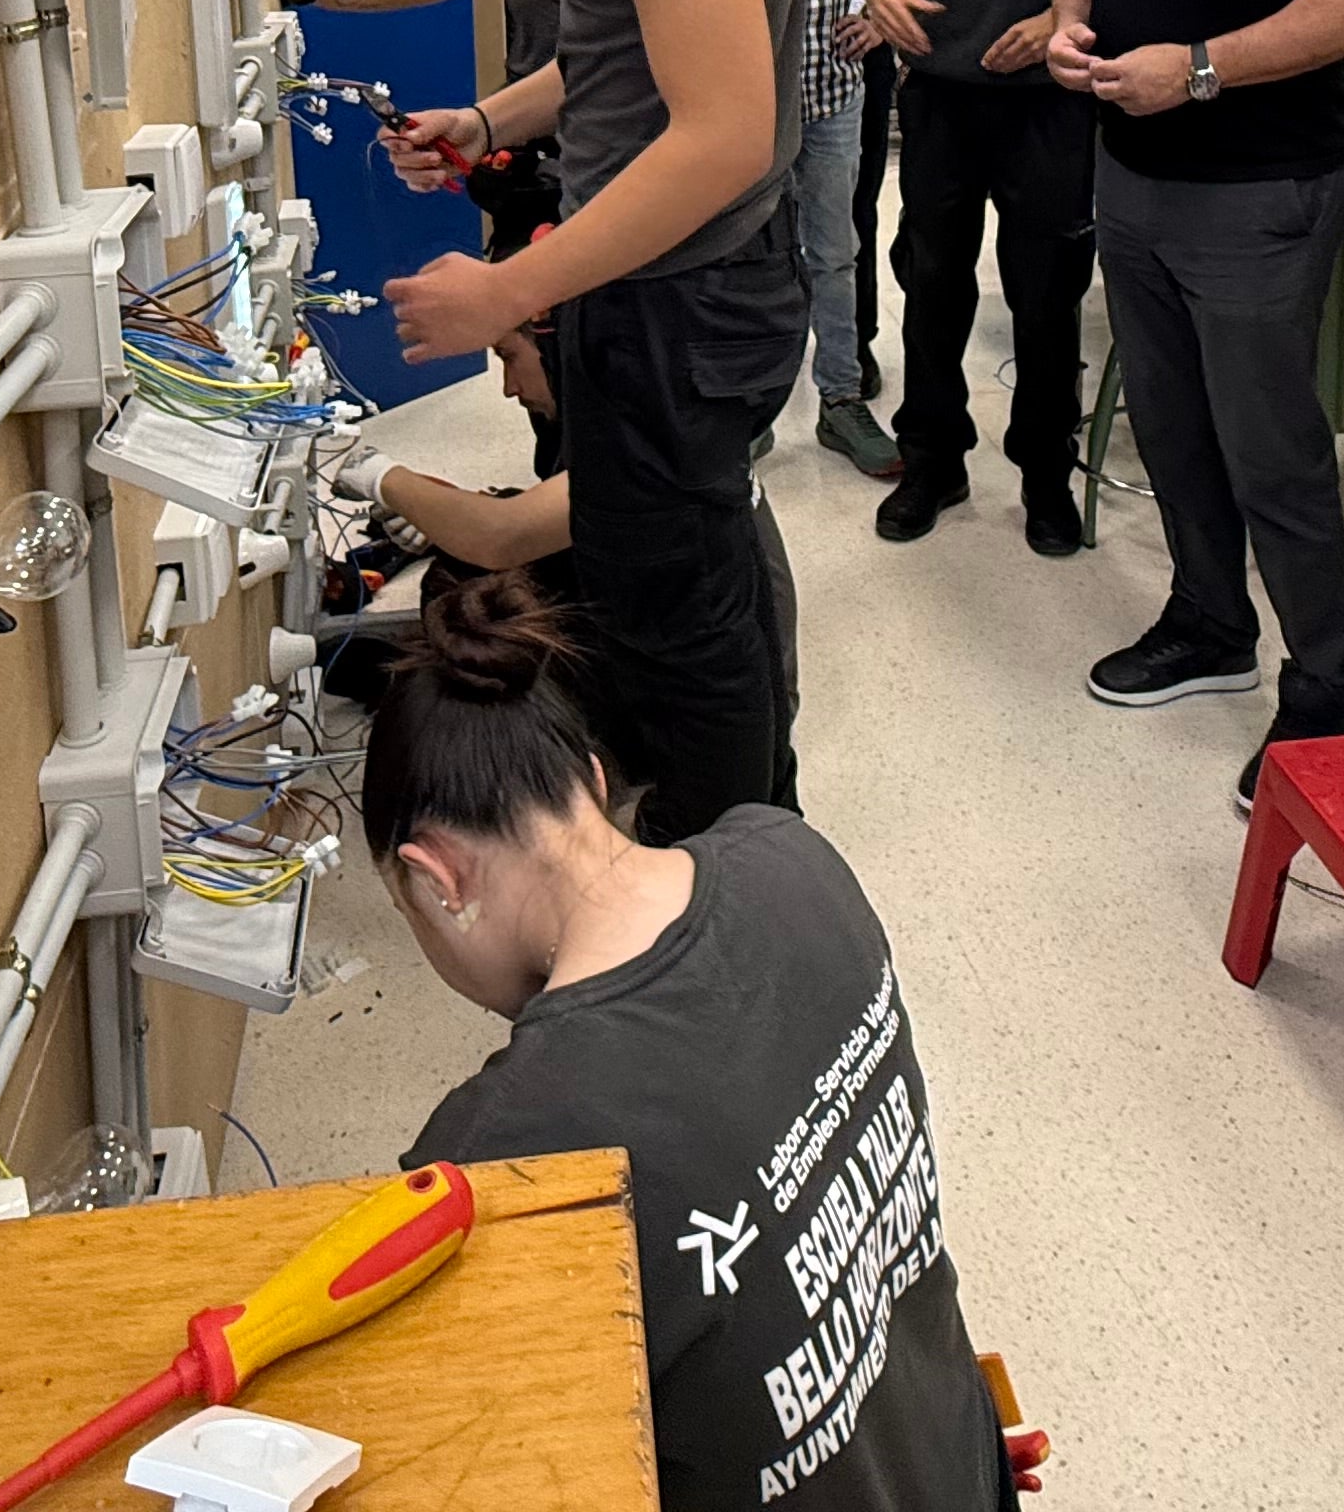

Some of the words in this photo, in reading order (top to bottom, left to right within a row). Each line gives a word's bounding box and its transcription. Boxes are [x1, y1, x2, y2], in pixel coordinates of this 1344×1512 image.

[757, 1116, 808, 1190] Labora
[815, 1025, 870, 1102] Servicio
[835, 1092, 851, 1120] y
[842, 1009, 900, 1102] Formación
[774, 1177, 799, 1212] de
[784, 1157, 875, 1319] ESCUELA
[857, 1075, 916, 1199] TALLER
[791, 1108, 841, 1186] Empleo
[763, 1297, 856, 1440] BELLO
[846, 1133, 936, 1338] HORIZONTE
[760, 1283, 892, 1504] AYUNTAMIENTO
[892, 1248, 921, 1300] DE
[919, 1217, 945, 1269] LA
